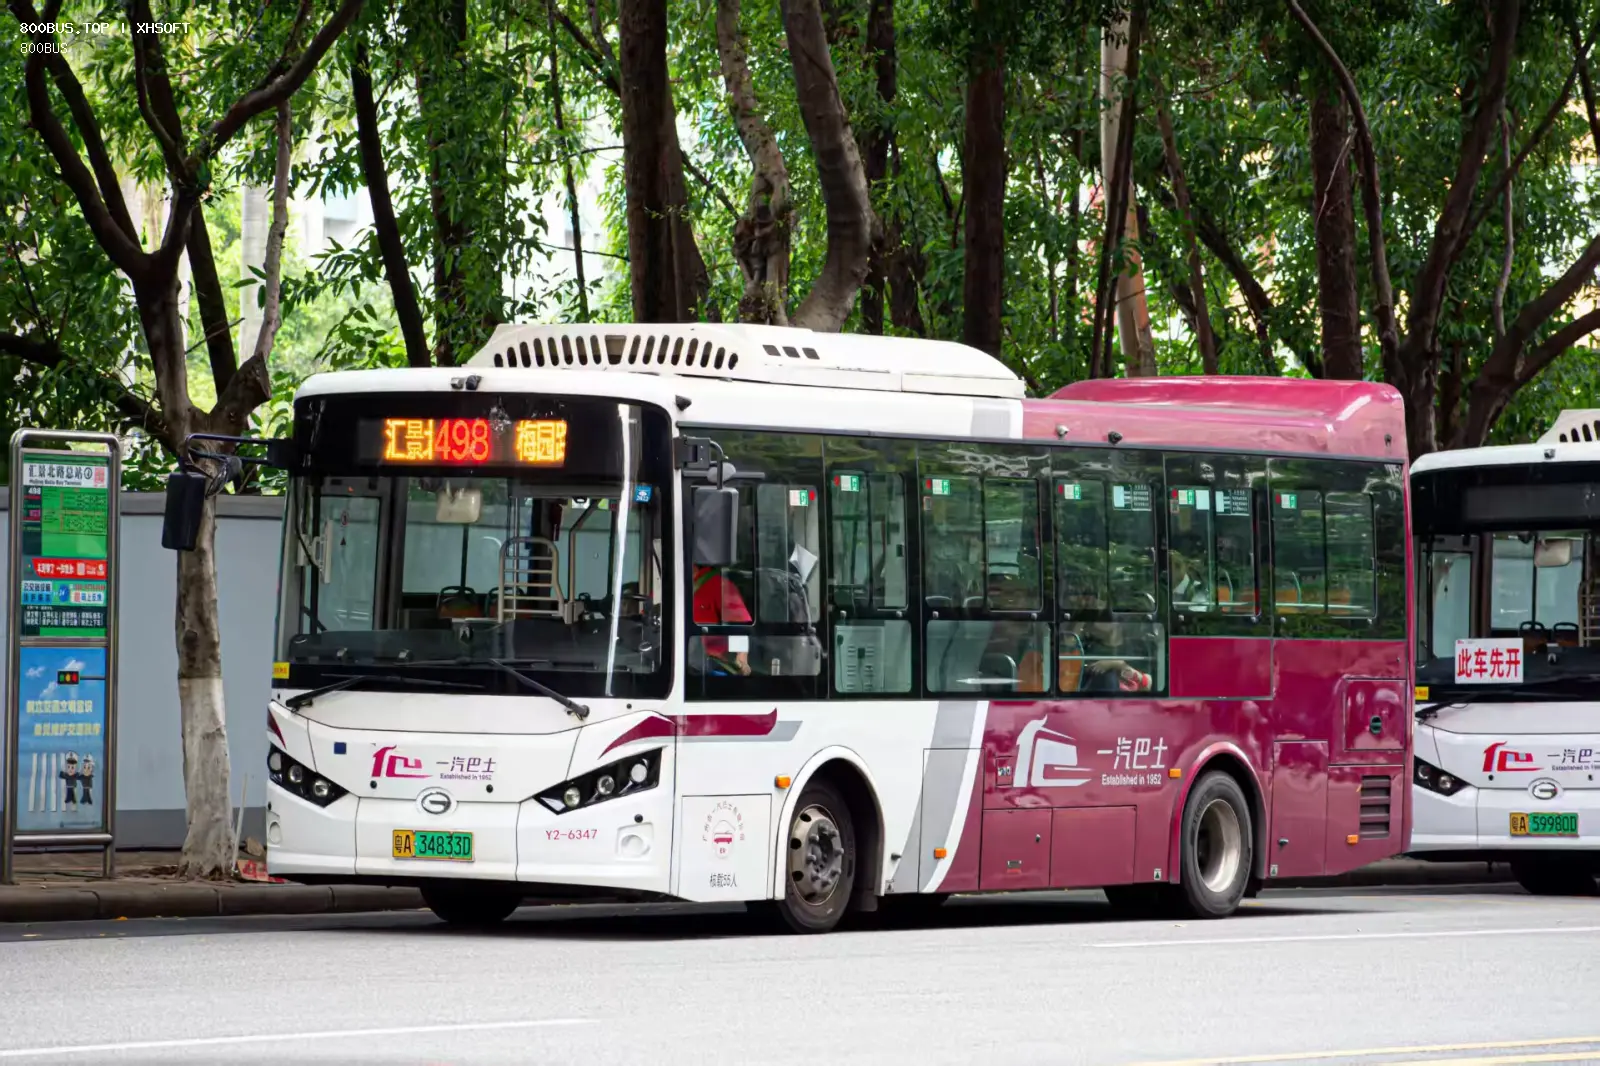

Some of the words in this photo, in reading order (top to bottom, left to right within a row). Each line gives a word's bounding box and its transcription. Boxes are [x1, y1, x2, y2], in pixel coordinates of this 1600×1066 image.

[435, 419, 489, 461] 498
[1457, 647, 1521, 679] 此车先开
[436, 756, 497, 773] 一汽巴士
[1096, 736, 1169, 770] 一汽巴士
[1101, 773, 1138, 786] Established
[1138, 773, 1146, 785] in
[1146, 773, 1162, 785] 1952
[545, 829, 598, 841] Y2-6347
